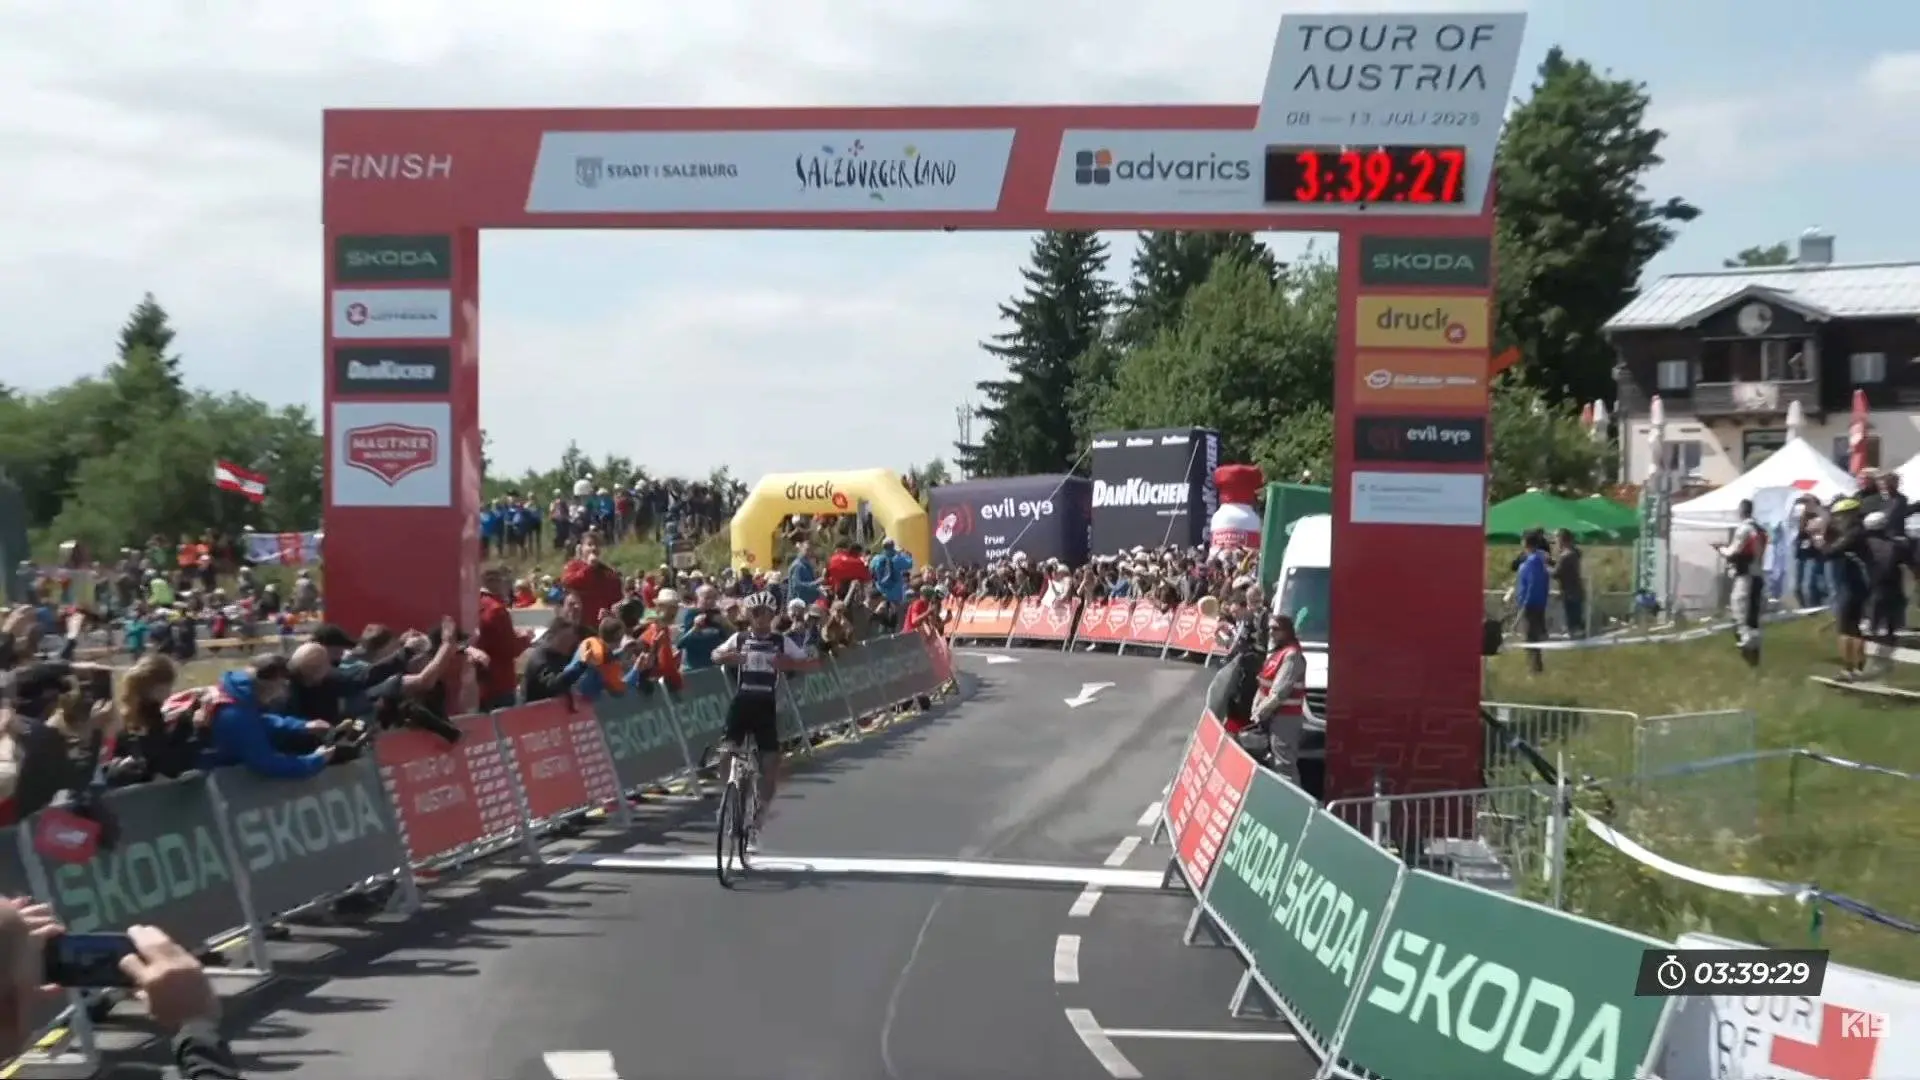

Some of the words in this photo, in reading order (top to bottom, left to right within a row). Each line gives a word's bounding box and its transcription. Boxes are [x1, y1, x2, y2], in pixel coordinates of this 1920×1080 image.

[1298, 24, 1418, 52] TOUR
[1435, 24, 1496, 51] OF
[1293, 63, 1488, 91] AUSTRIA
[1381, 111, 1427, 127] JULI
[329, 154, 453, 180] FINISH
[607, 163, 650, 179] STADT
[662, 163, 739, 179] SALZBURG
[1116, 152, 1251, 181] advarics
[1296, 149, 1466, 204] 3:39:27
[1377, 305, 1450, 331] druck
[353, 437, 430, 449] MAUTNER
[1407, 425, 1437, 441] evil
[1440, 429, 1472, 445] eye
[786, 480, 834, 500] druck
[981, 497, 1015, 520] evil
[1018, 499, 1054, 521] eye
[984, 535, 1006, 545] true
